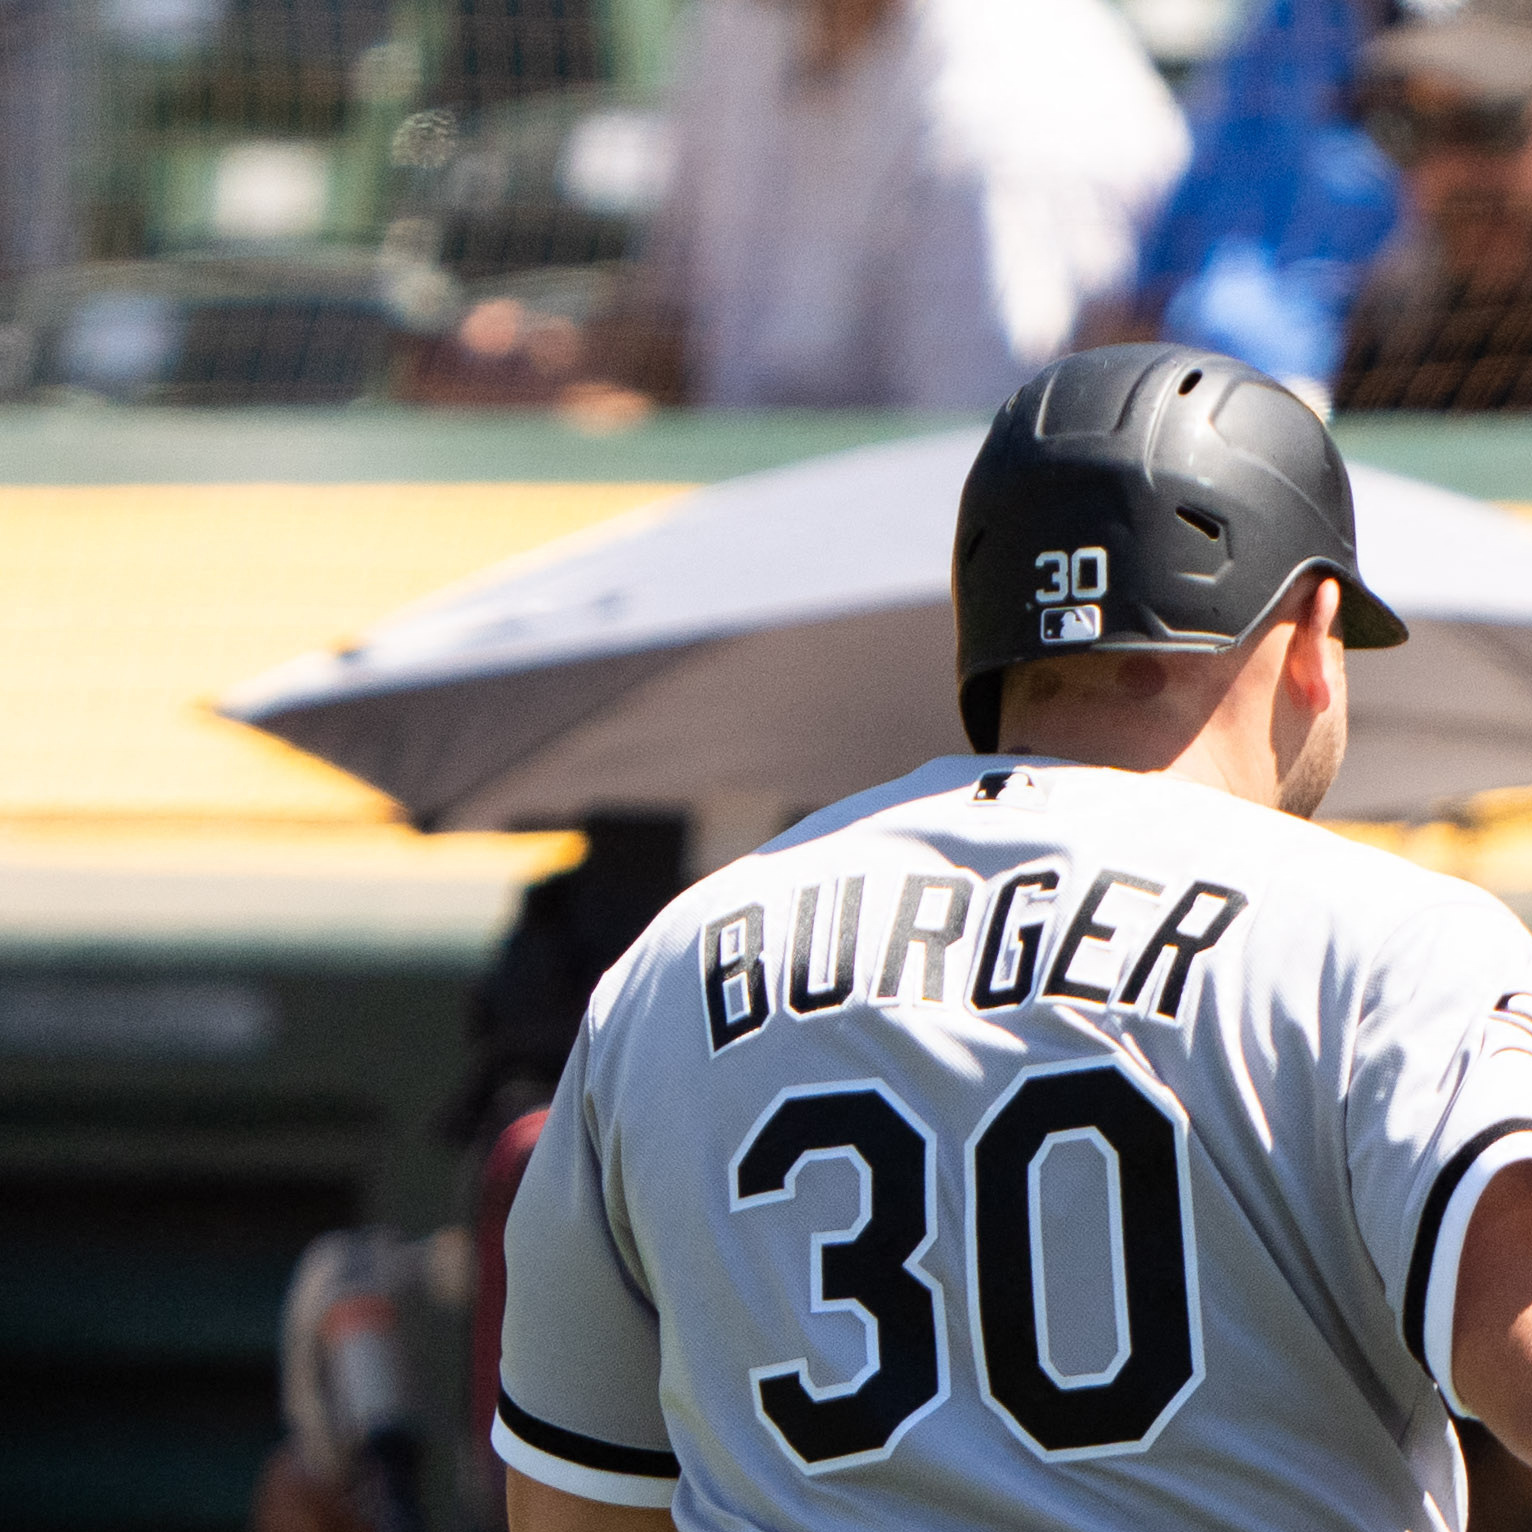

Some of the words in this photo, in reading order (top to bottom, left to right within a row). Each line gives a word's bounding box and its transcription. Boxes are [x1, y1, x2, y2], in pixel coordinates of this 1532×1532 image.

[1035, 546, 1107, 602] 30
[700, 855, 1249, 1058] BURGER
[728, 1053, 1206, 1475] 30
